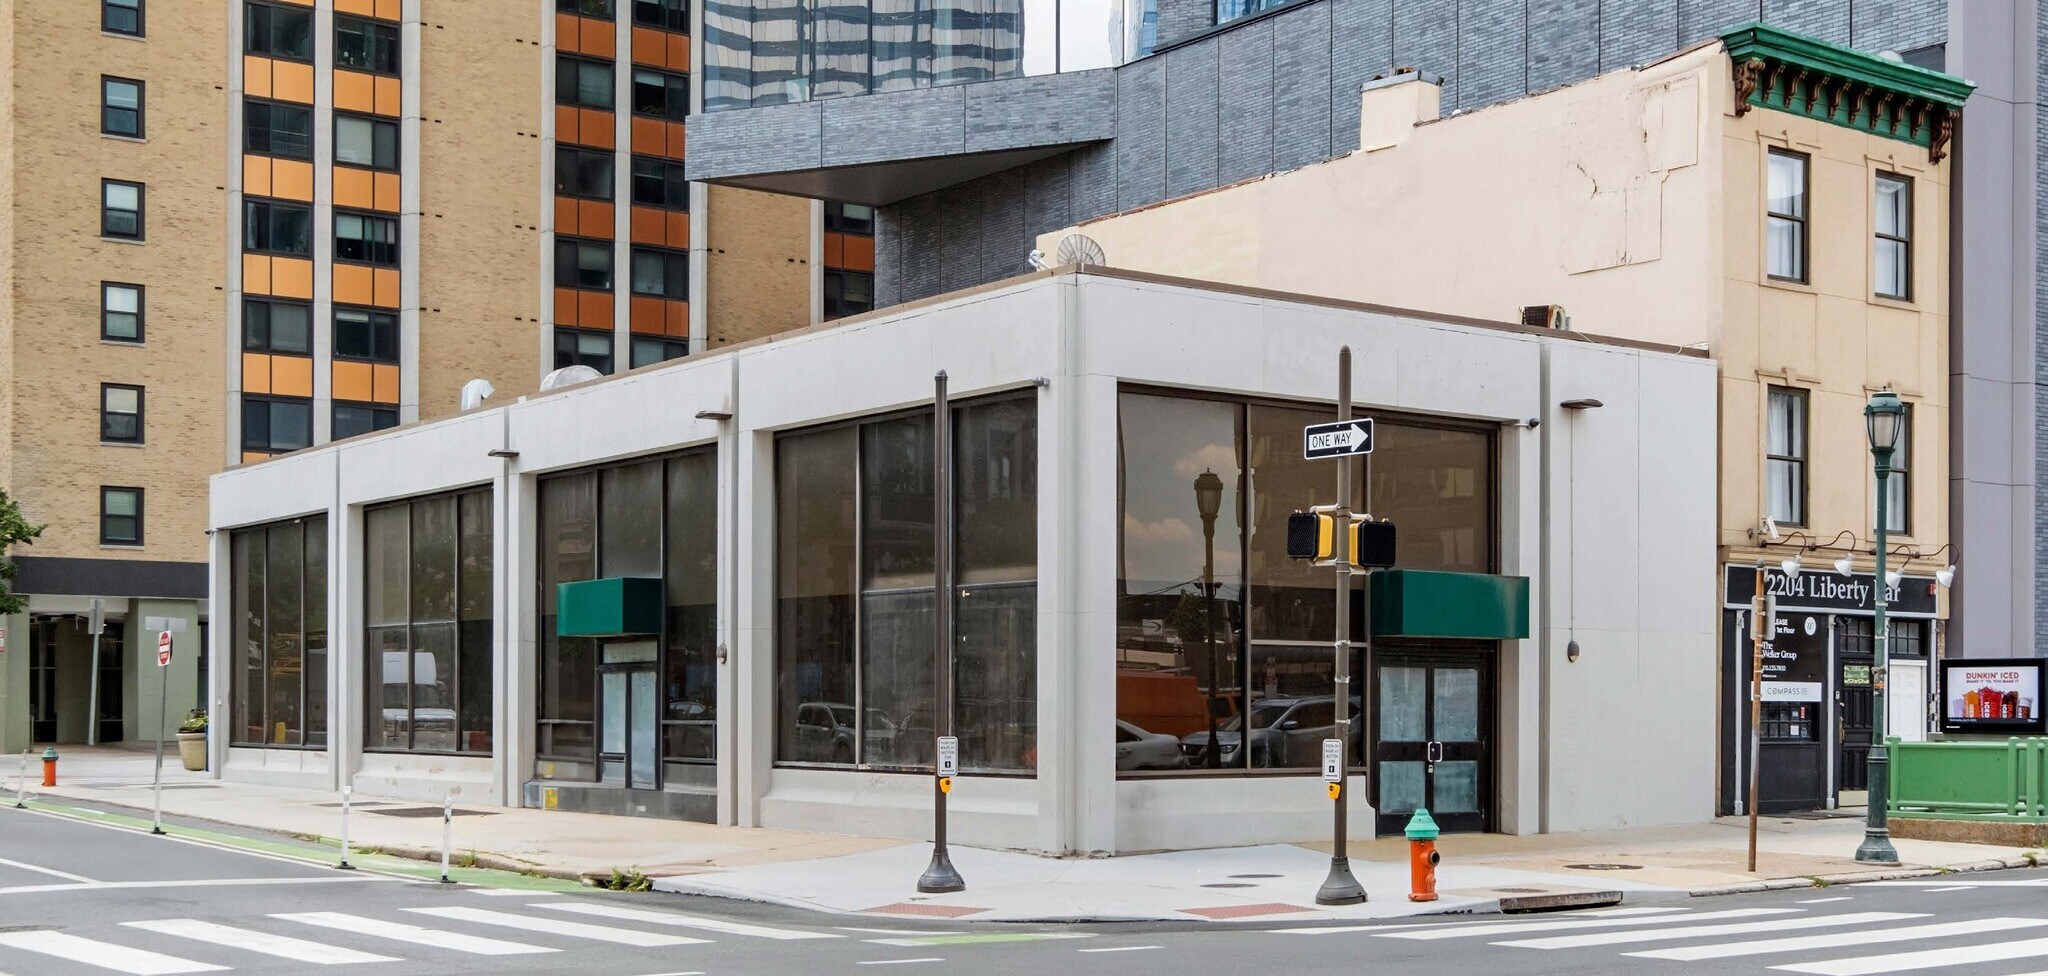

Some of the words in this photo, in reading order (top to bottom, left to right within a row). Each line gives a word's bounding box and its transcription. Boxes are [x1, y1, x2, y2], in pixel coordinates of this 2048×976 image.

[1312, 434, 1330, 448] ONE
[1333, 432, 1352, 446] WAY
[1766, 574, 1804, 597] 2204
[1809, 575, 1869, 607] Liberty
[1783, 626, 1795, 634] Floor
[1762, 641, 1773, 650] The
[1780, 650, 1797, 661] Group
